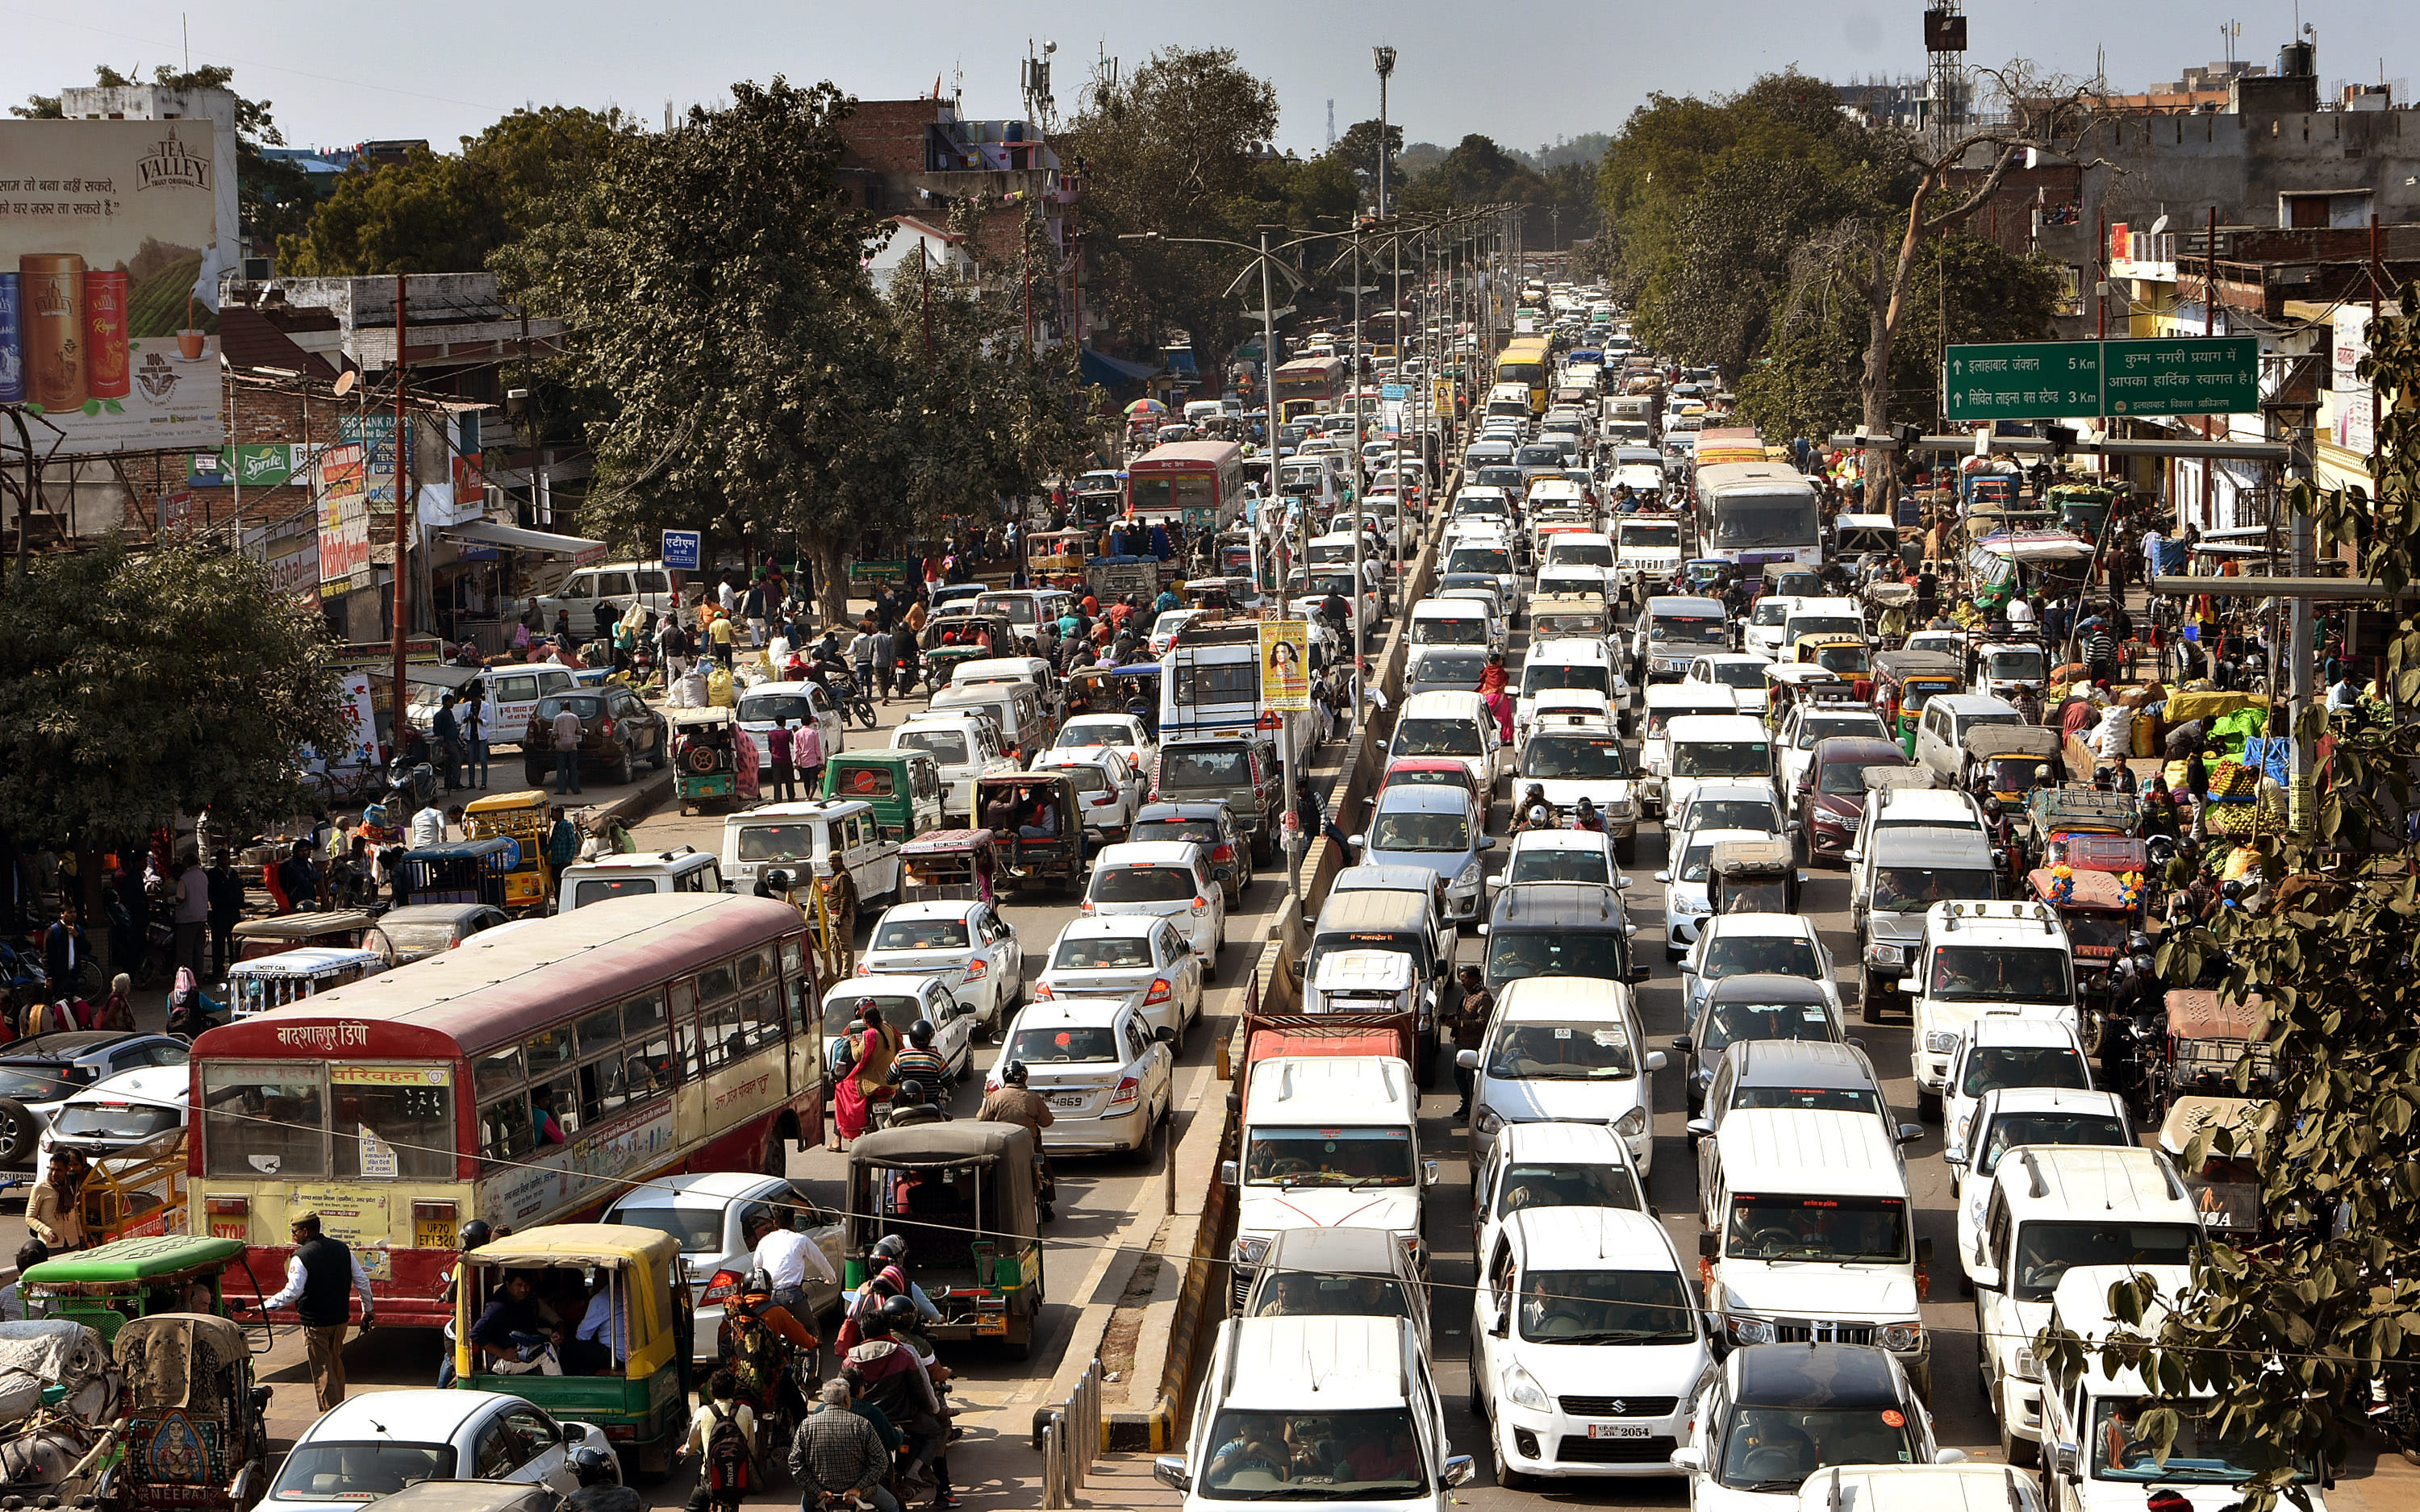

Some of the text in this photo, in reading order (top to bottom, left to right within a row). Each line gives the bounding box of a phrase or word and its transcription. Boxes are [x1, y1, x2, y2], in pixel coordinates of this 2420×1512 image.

[158, 141, 186, 157] TEA
[140, 157, 207, 185] VALLEY
[24, 177, 35, 191] तो
[39, 180, 59, 191] बना
[63, 177, 81, 193] नहीं
[169, 178, 194, 187] ORIGINAL
[14, 203, 27, 215] घर
[58, 203, 69, 215] ला
[73, 200, 101, 215] सकते
[146, 353, 165, 366] 100%
[1968, 356, 2096, 374] इलाहाबाद जंक्शन 5 Km
[2125, 348, 2237, 368] कुम्भ नगरी प्रयाग में
[2109, 376, 2147, 387] आपका
[2153, 372, 2190, 386] हार्दिक
[2196, 374, 2233, 385] स्वागत
[1969, 389, 1992, 406] सिविल
[1996, 392, 2019, 406] लाइन्स
[2068, 391, 2076, 403] 3
[2081, 393, 2096, 403] Km
[2132, 401, 2165, 410] इलाहाबाद
[2171, 398, 2193, 408] विकास
[360, 417, 383, 427] ANK
[247, 455, 281, 476] Sprite
[666, 535, 695, 549] एटीएम
[319, 530, 348, 578] Vishal
[277, 1021, 369, 1051] बादशाहपुर डिपो
[332, 1067, 421, 1083] परिवहन
[1052, 1098, 1083, 1106] 4869
[212, 1223, 247, 1240] STOP
[428, 1223, 449, 1234] UP70
[1621, 1428, 1650, 1437] 2054
[151, 1489, 207, 1500] NEERAJ
